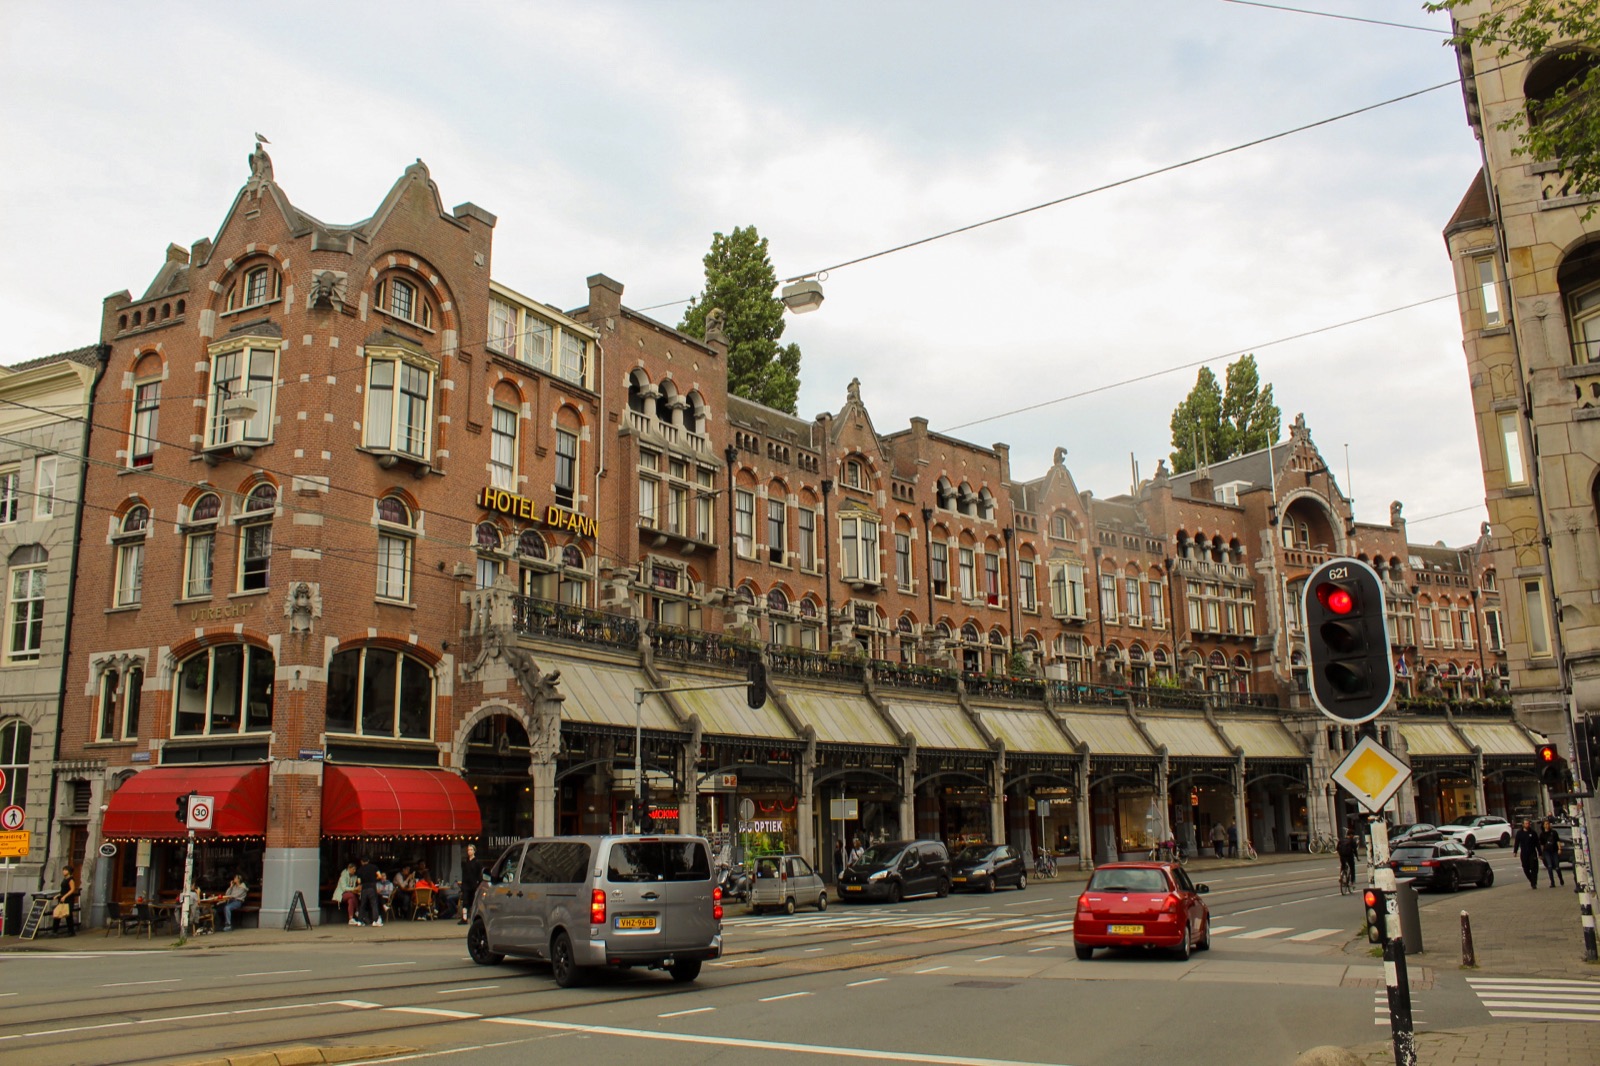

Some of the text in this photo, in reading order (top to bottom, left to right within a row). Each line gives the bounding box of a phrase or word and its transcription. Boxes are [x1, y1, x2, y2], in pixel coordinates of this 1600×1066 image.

[485, 487, 599, 539] HOTEL DI-ANN
[1329, 566, 1348, 580] 621
[195, 808, 206, 817] 30
[754, 820, 783, 833] OPTIEK
[621, 918, 654, 927] VHZ-96-B
